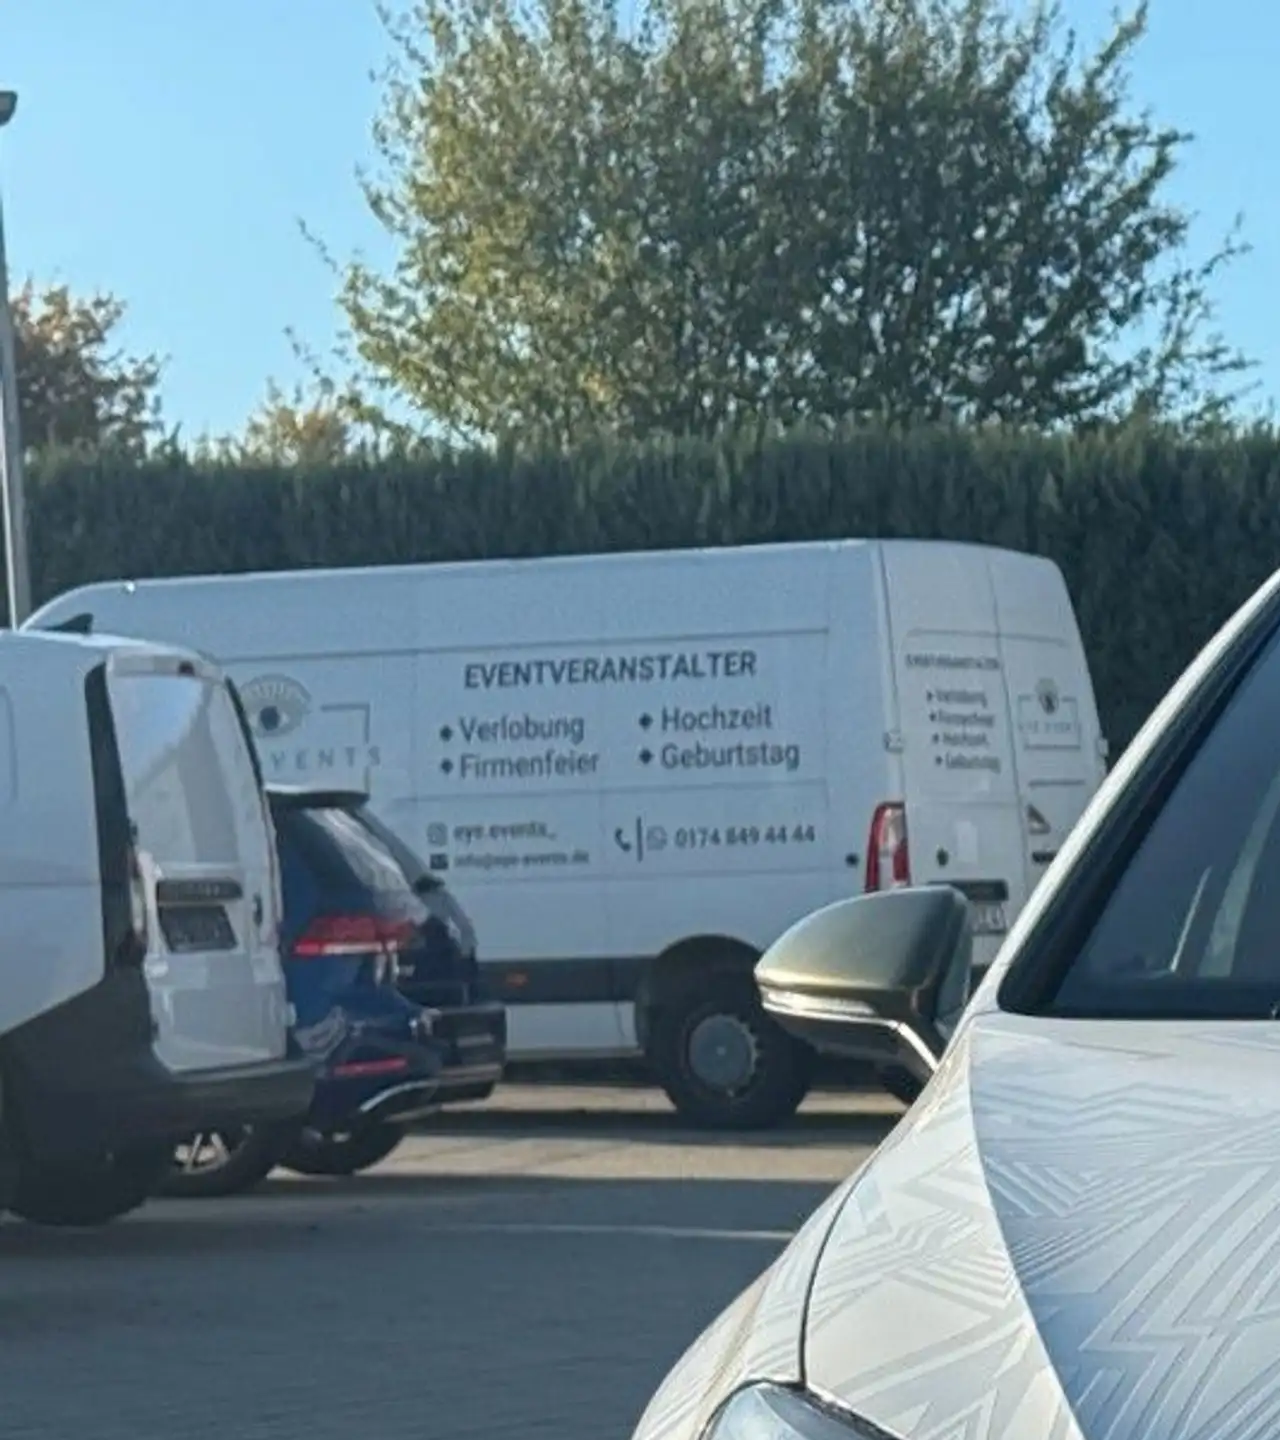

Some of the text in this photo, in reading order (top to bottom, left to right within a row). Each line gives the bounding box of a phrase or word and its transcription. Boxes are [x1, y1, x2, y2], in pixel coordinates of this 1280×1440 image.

[464, 650, 758, 689] EVENTVERANSTALTER
[458, 714, 586, 746] Verlobung
[661, 704, 773, 732] Hochzeit
[270, 745, 382, 771] VENTS
[459, 749, 600, 780] Firmenfeier
[660, 741, 801, 772] Geburtstag
[674, 826, 721, 849] 0174
